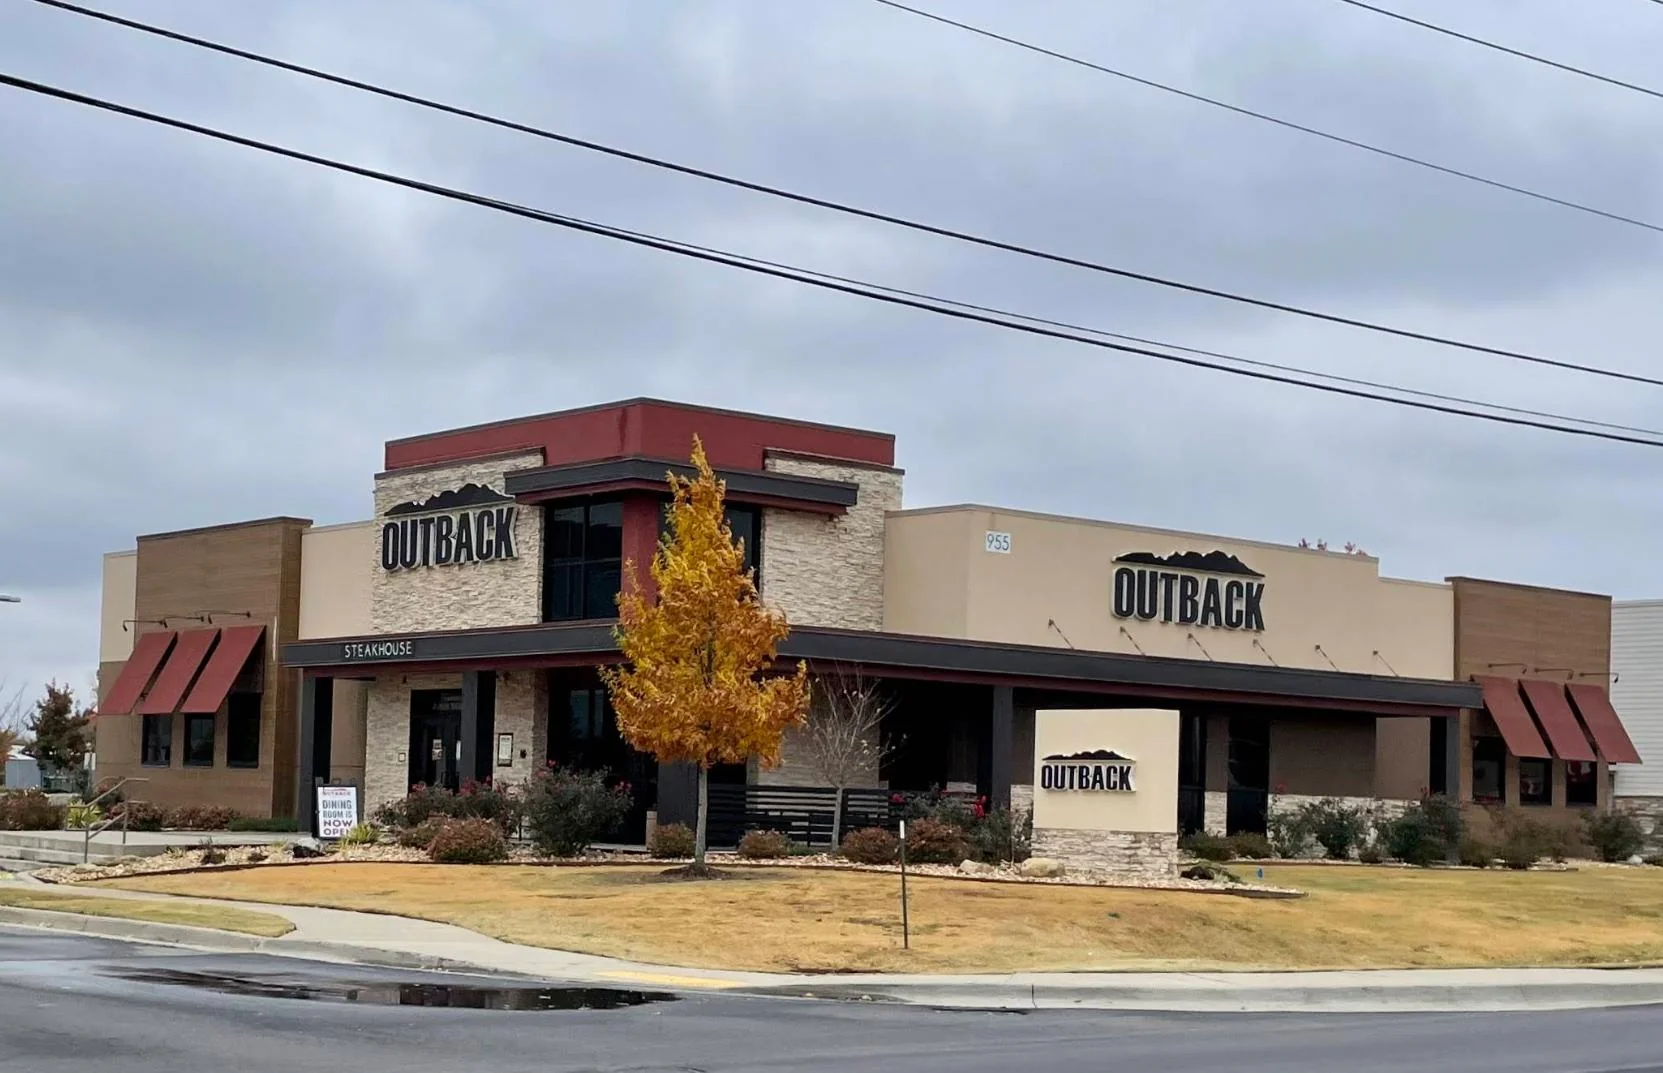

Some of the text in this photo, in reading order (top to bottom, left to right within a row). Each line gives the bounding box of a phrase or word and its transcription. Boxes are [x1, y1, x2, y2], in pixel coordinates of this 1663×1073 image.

[382, 506, 516, 570] OUTBACK
[987, 533, 1009, 551] 955
[1114, 567, 1265, 631] OUTBACK
[344, 641, 412, 658] STEAKHOUSE
[1041, 765, 1132, 791] OUTBACK
[322, 800, 352, 809] DINING
[323, 819, 353, 827] NOW
